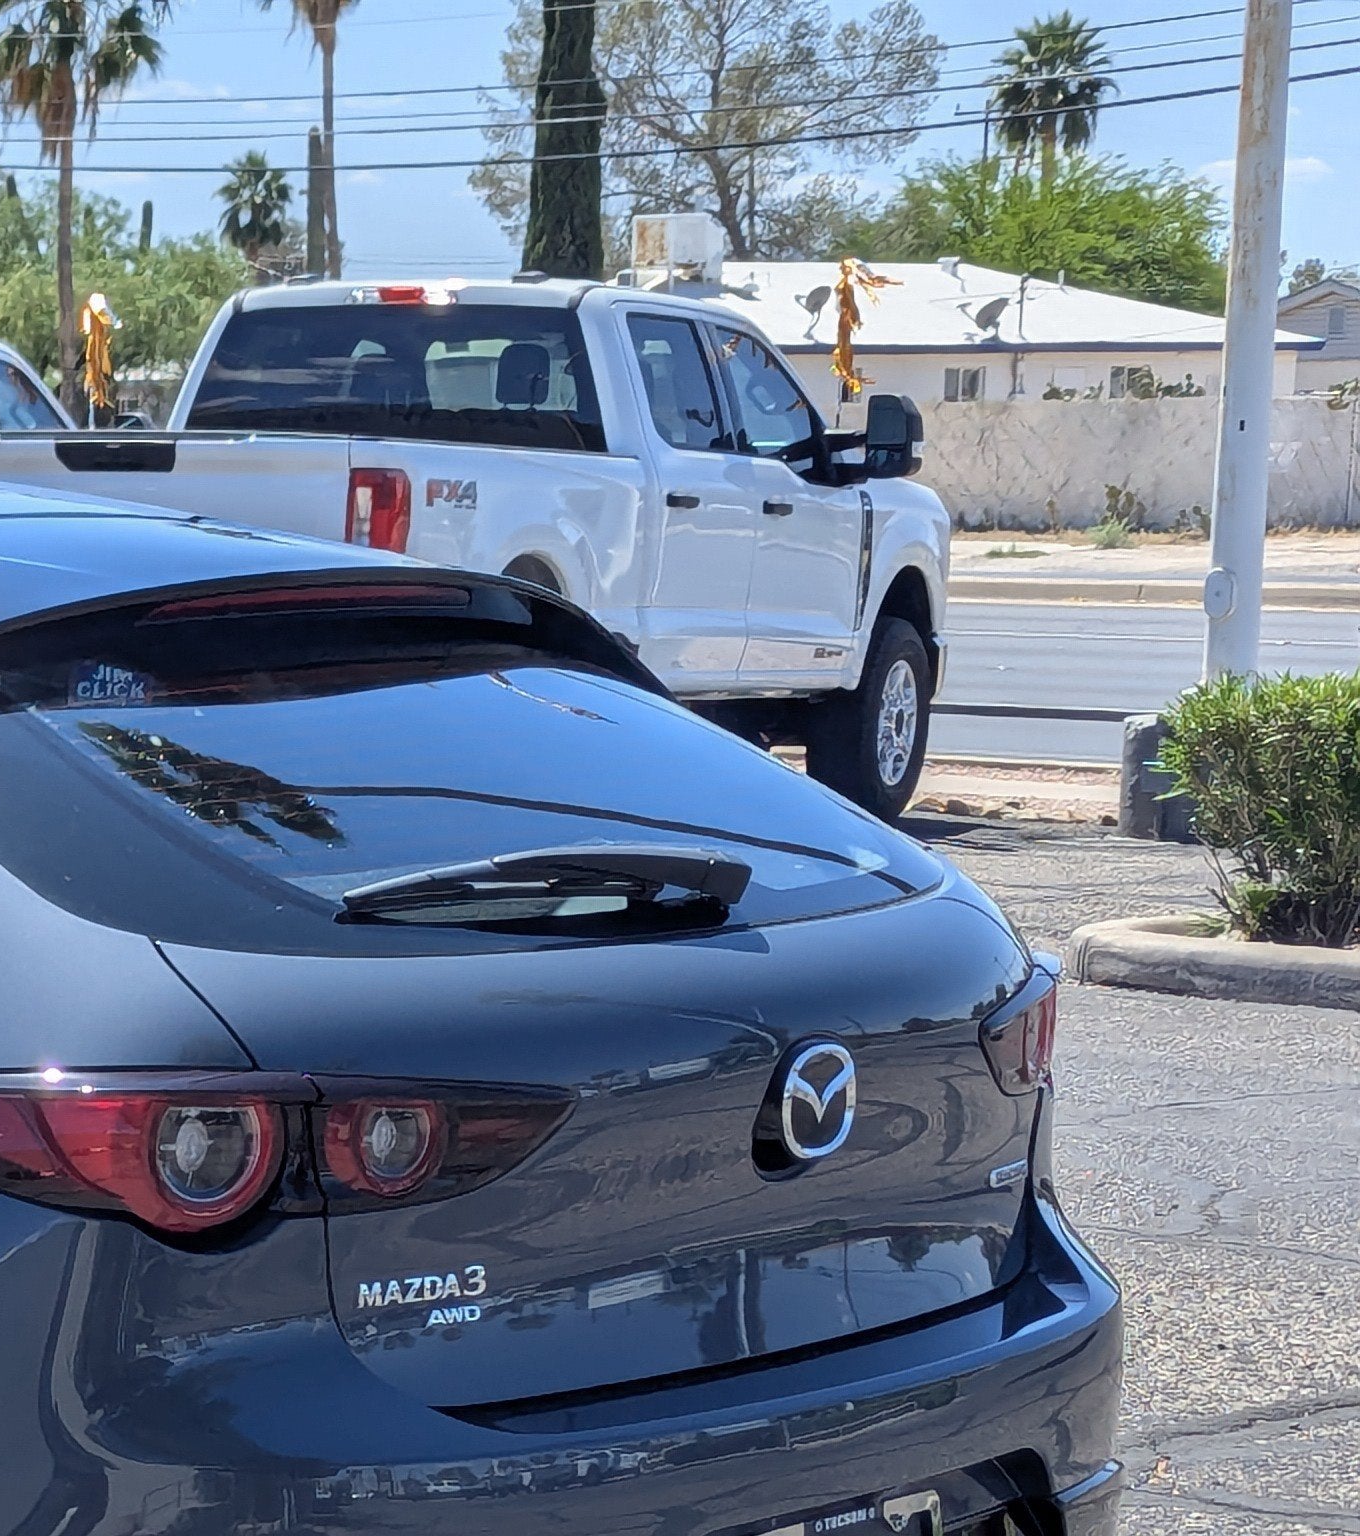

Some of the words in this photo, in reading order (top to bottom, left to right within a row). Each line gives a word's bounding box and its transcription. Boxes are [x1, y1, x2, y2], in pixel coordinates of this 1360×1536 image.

[426, 479, 477, 507] FX4
[93, 664, 133, 683] JIM
[77, 681, 145, 699] CLICK
[425, 1305, 481, 1329] AWD
